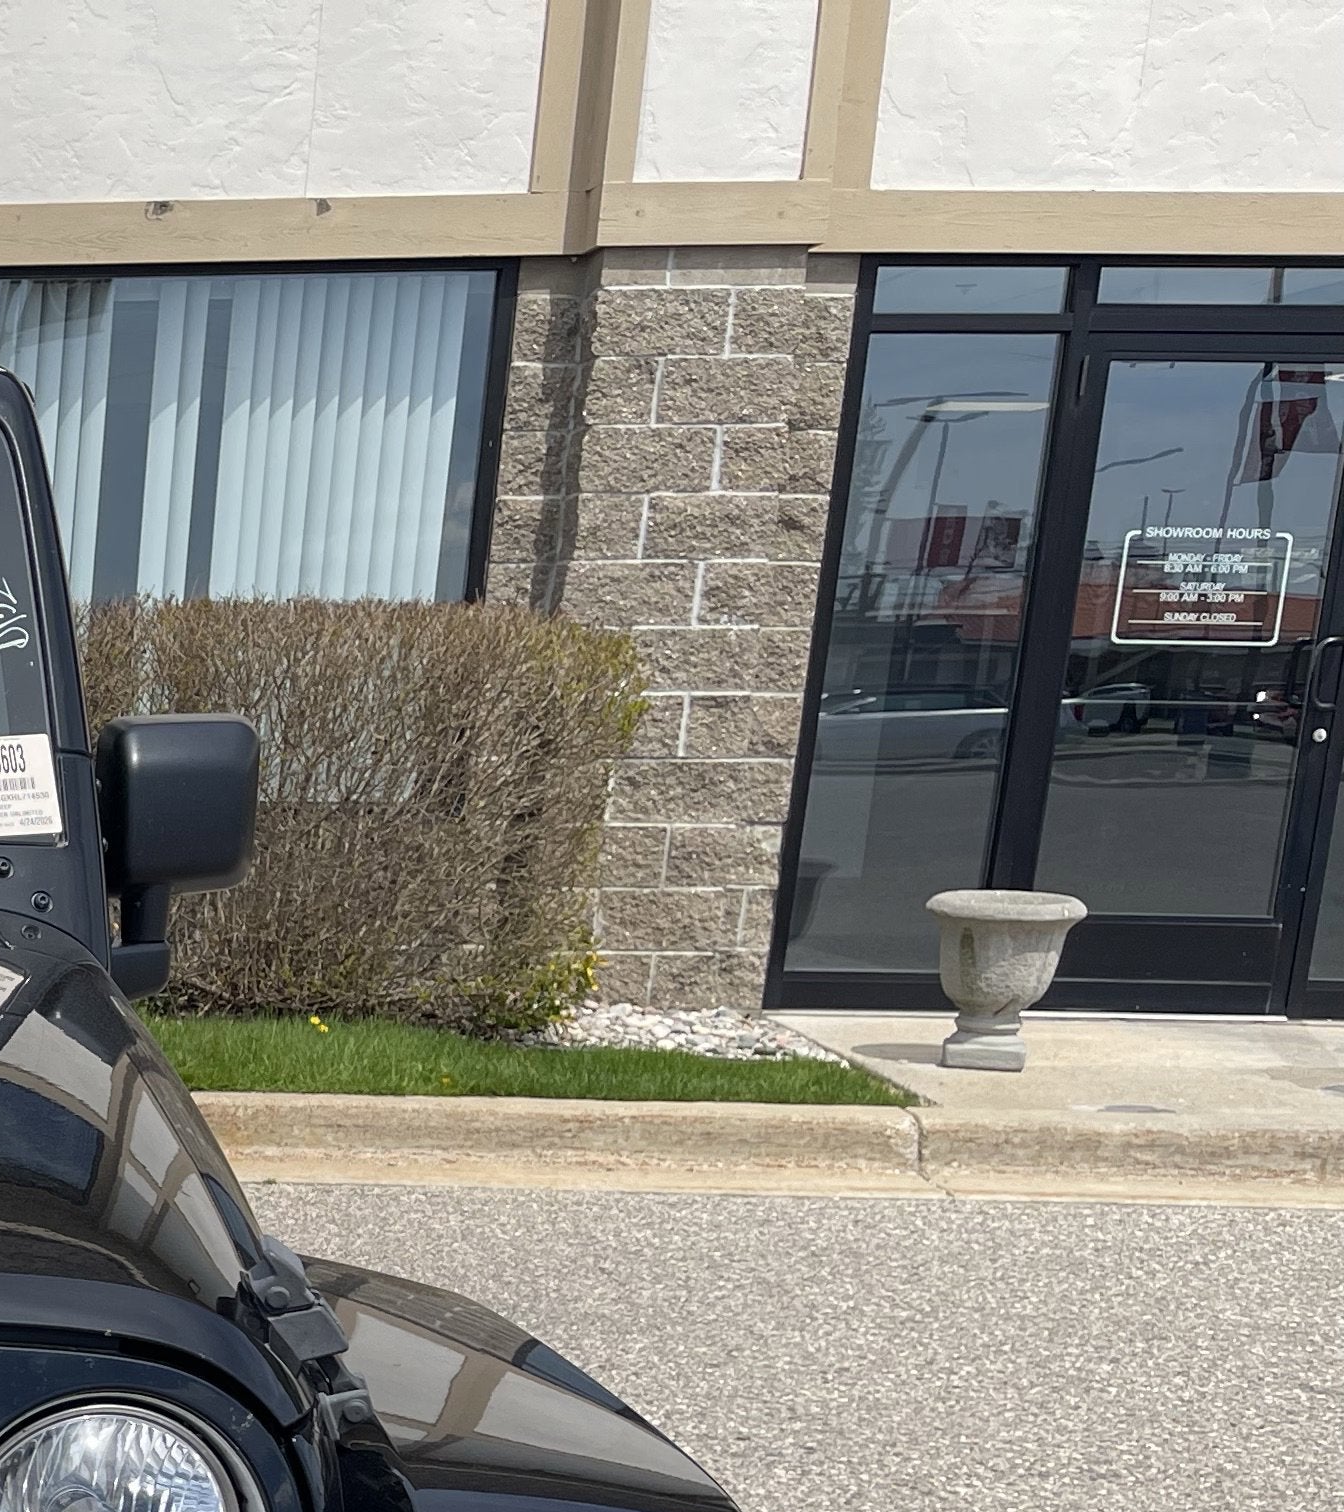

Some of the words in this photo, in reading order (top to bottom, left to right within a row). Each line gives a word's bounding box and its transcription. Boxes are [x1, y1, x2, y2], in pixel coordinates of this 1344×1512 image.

[1145, 526, 1223, 539] SHOWROOM
[1227, 527, 1272, 540] HOURS
[1168, 553, 1206, 562] MONDAY
[1212, 554, 1244, 563] FRIDAY
[1186, 565, 1202, 573] AM
[1233, 565, 1248, 574] PM
[1179, 582, 1226, 591] SATURDAY
[1159, 593, 1179, 602] 9:00
[1181, 593, 1198, 602] AM
[1206, 593, 1226, 602] 3:00
[1229, 594, 1244, 603] PM
[1164, 612, 1198, 622] SUNDAY
[1200, 613, 1237, 622] CLOSED
